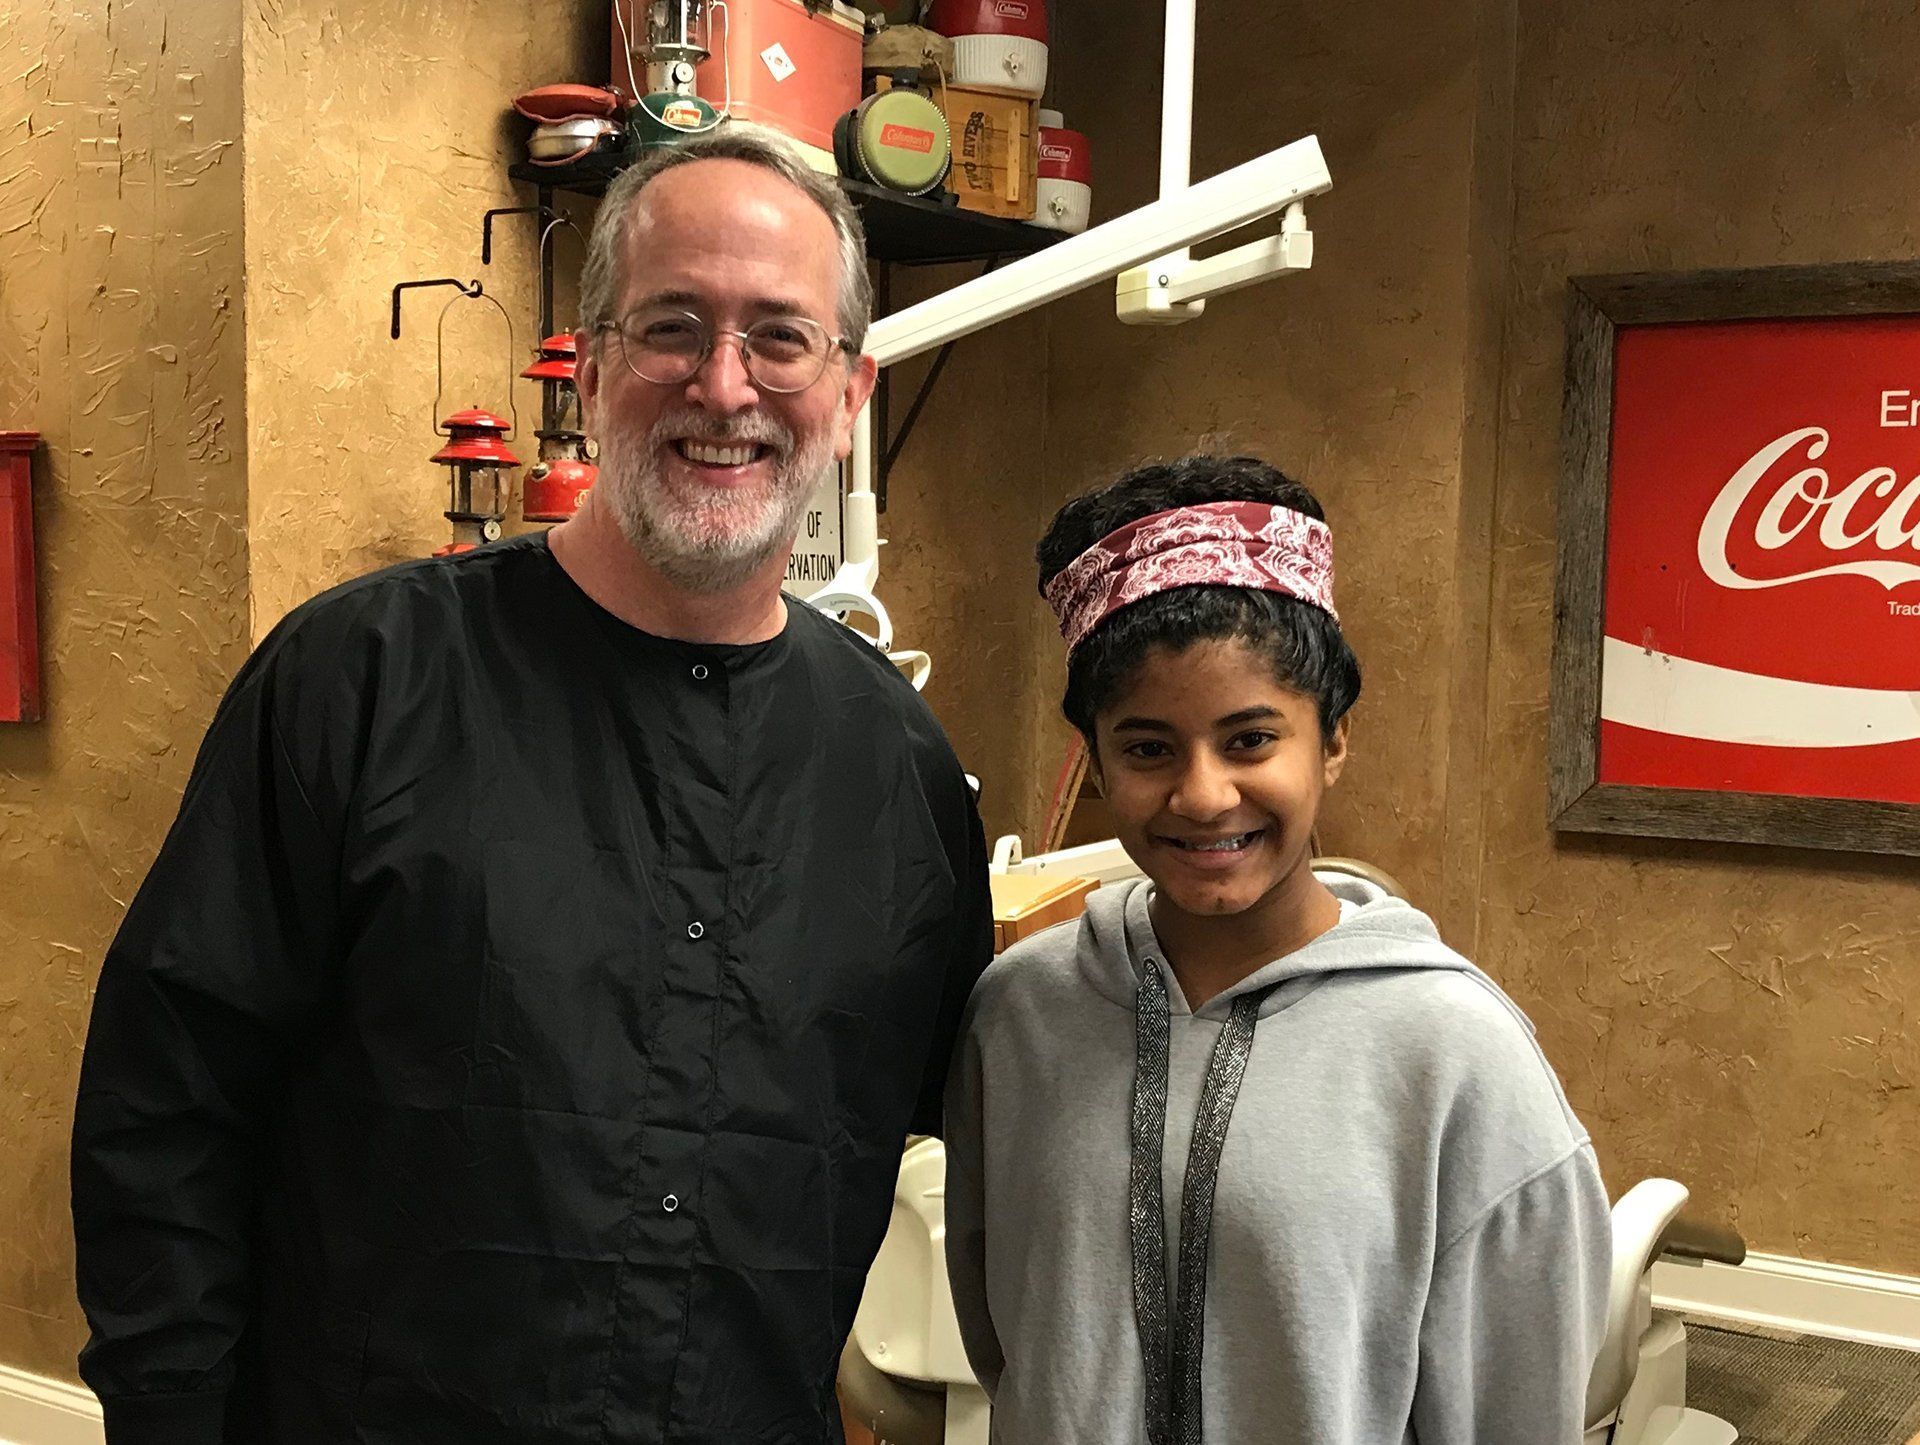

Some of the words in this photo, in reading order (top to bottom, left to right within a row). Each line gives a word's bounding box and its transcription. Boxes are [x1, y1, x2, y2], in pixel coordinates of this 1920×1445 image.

[962, 111, 984, 157] RIVERS
[963, 161, 983, 190] TWO
[807, 510, 822, 538] OF
[783, 553, 835, 581] RVATION
